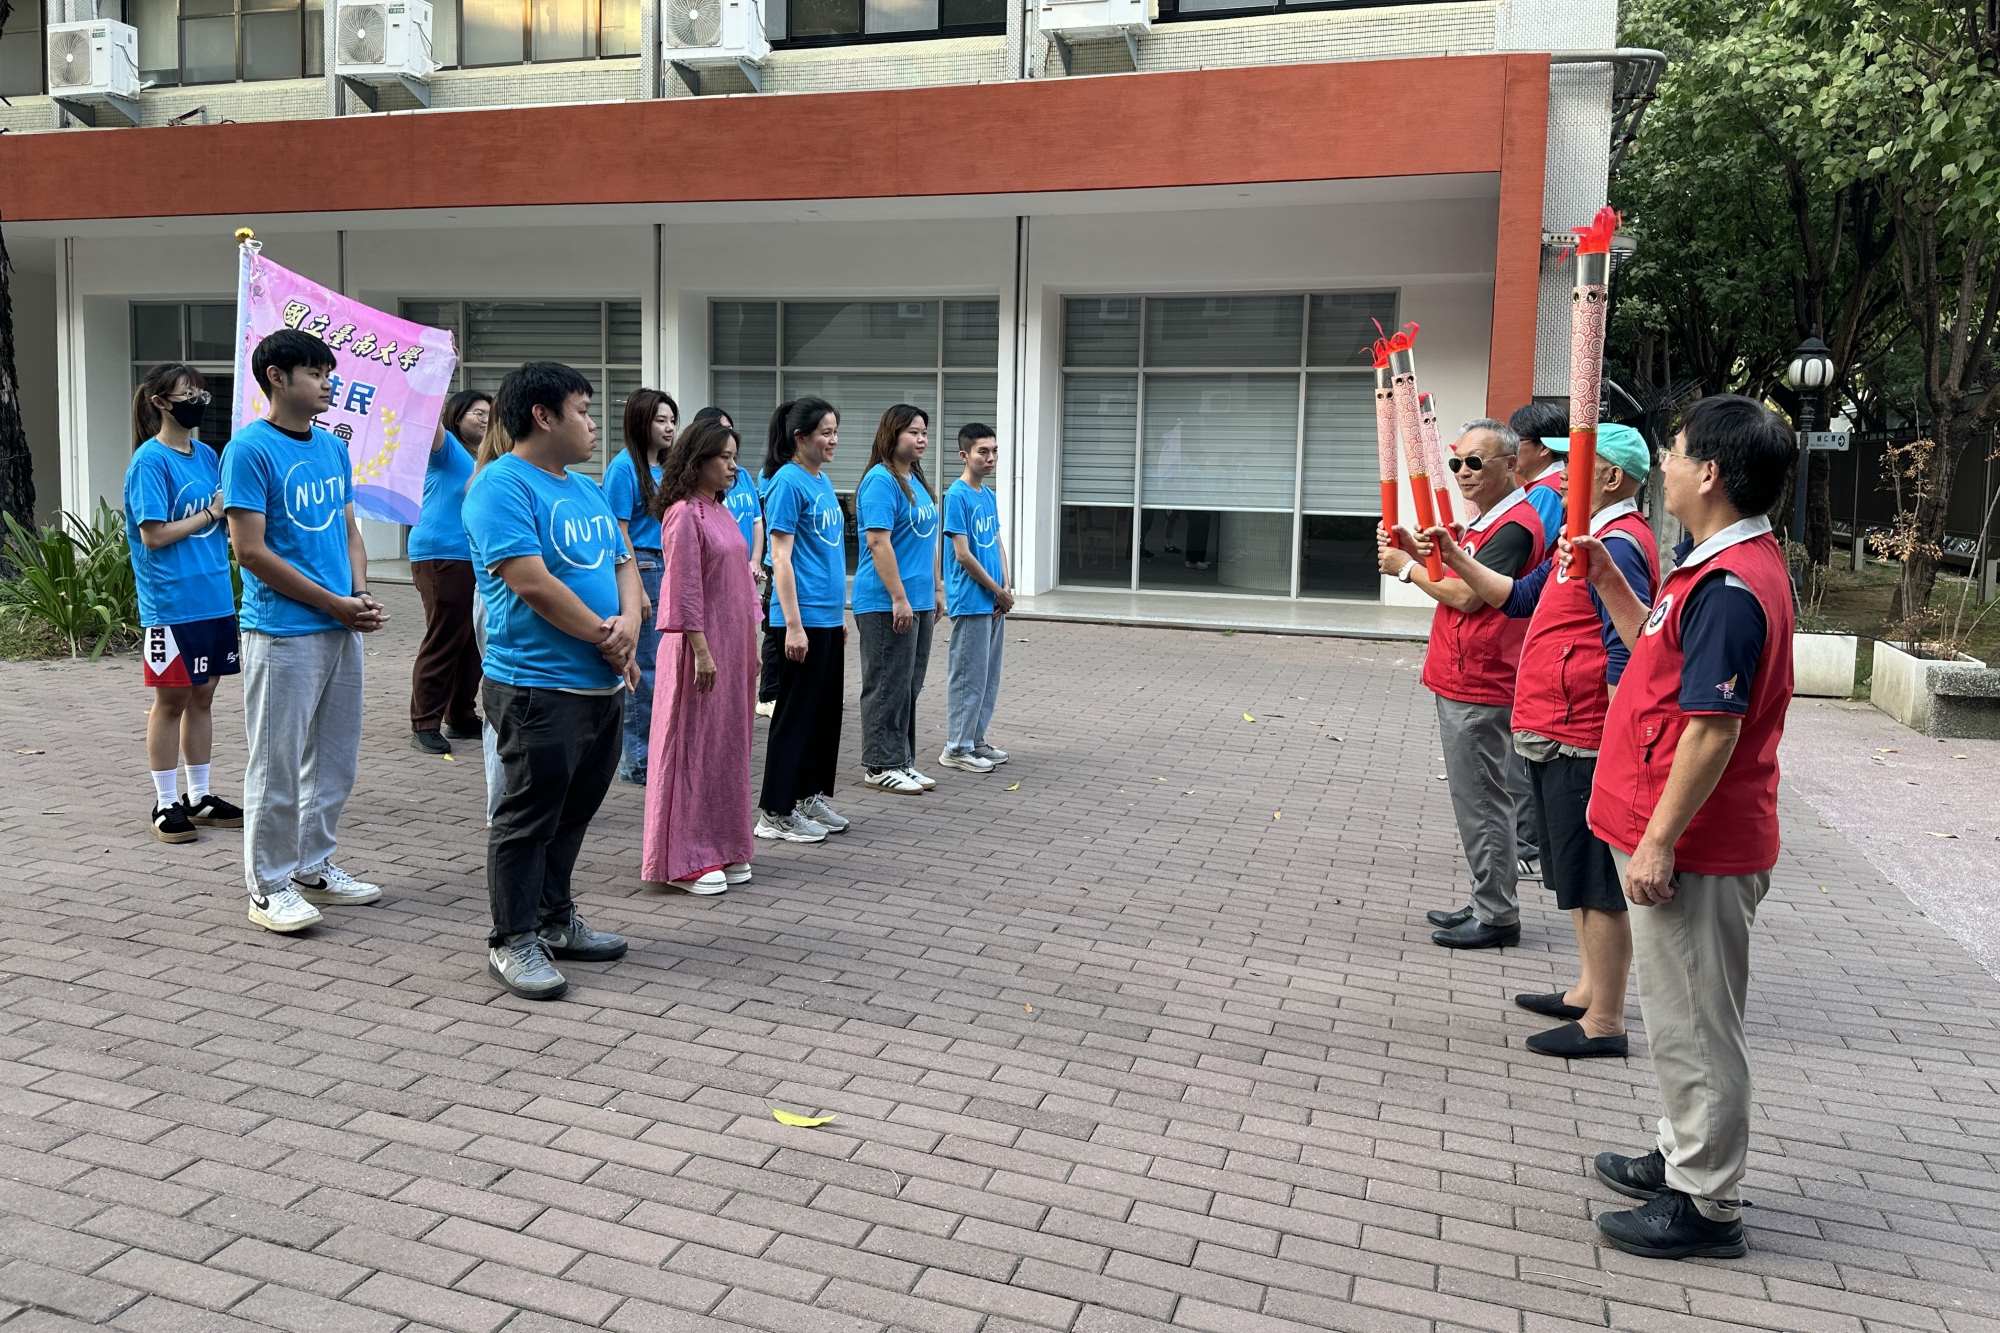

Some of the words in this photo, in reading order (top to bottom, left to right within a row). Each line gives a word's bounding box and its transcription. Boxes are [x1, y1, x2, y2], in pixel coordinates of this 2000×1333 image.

[282, 300, 425, 372] 國立臺南大學
[193, 656, 209, 674] 16
